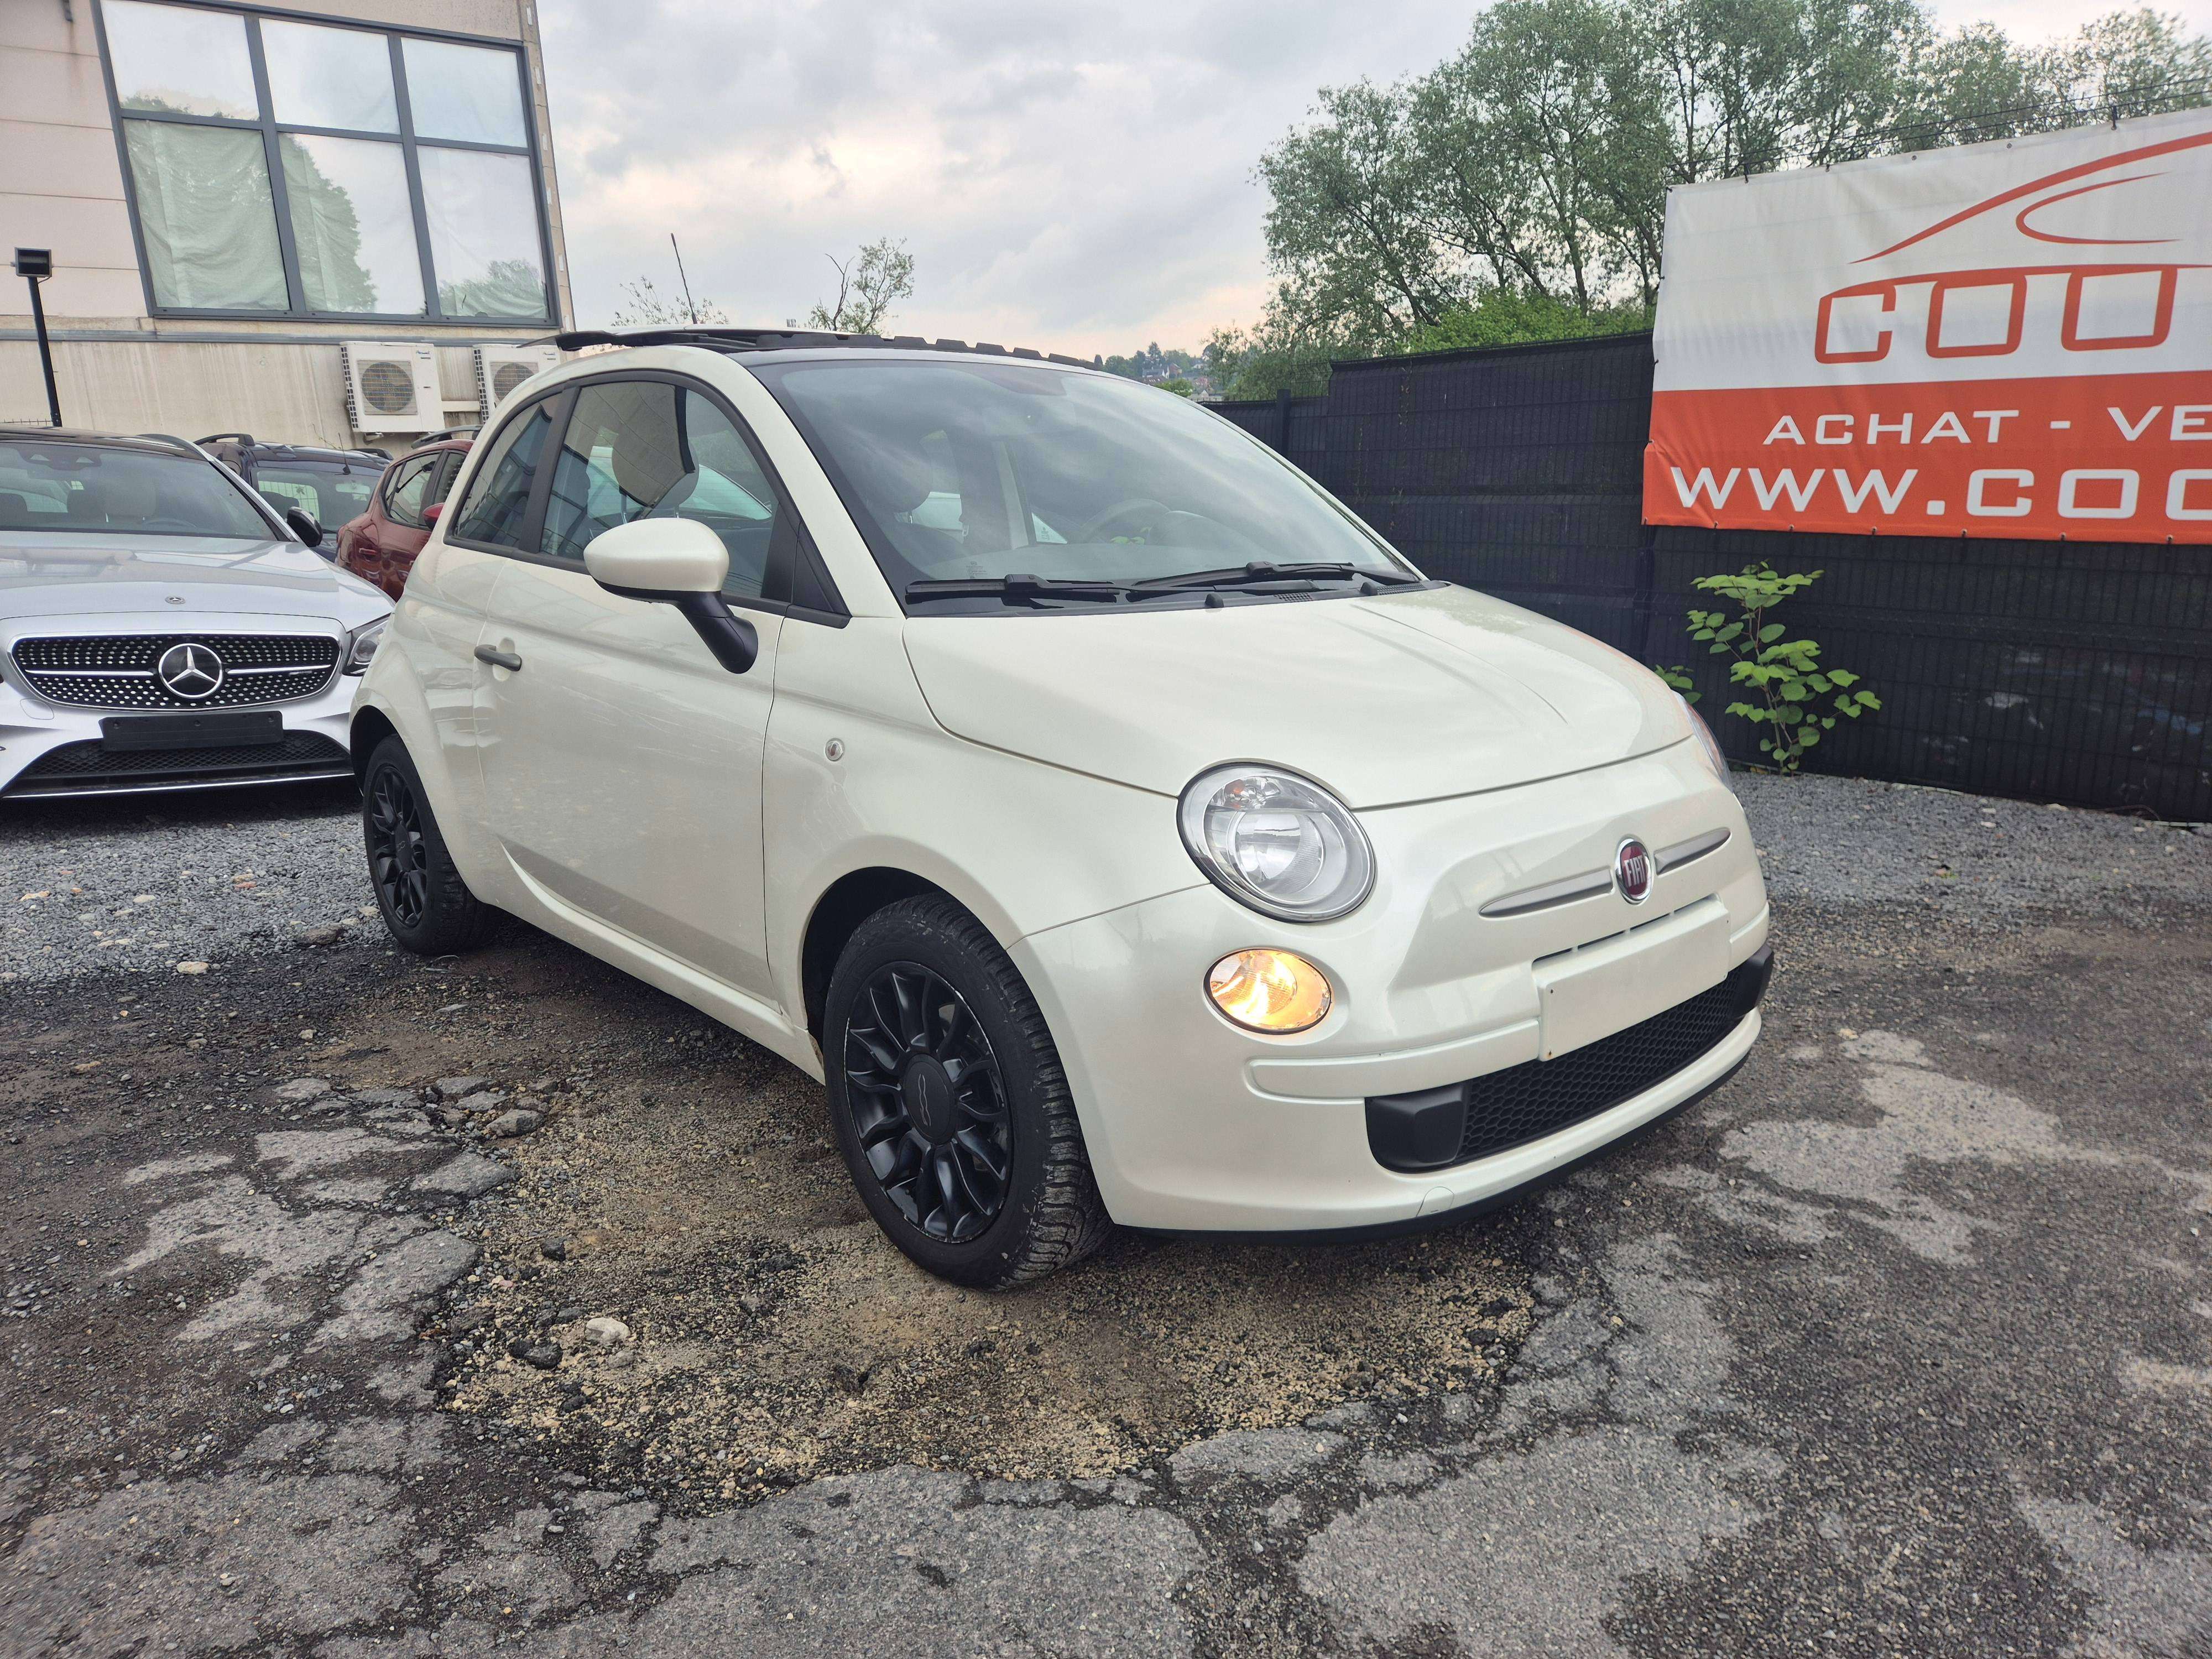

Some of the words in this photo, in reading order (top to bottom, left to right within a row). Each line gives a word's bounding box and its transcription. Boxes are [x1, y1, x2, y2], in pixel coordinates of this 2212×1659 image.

[1762, 410, 2020, 445] ACHAT
[2107, 404, 2212, 441] VE
[1624, 855, 1646, 887] FIAT
